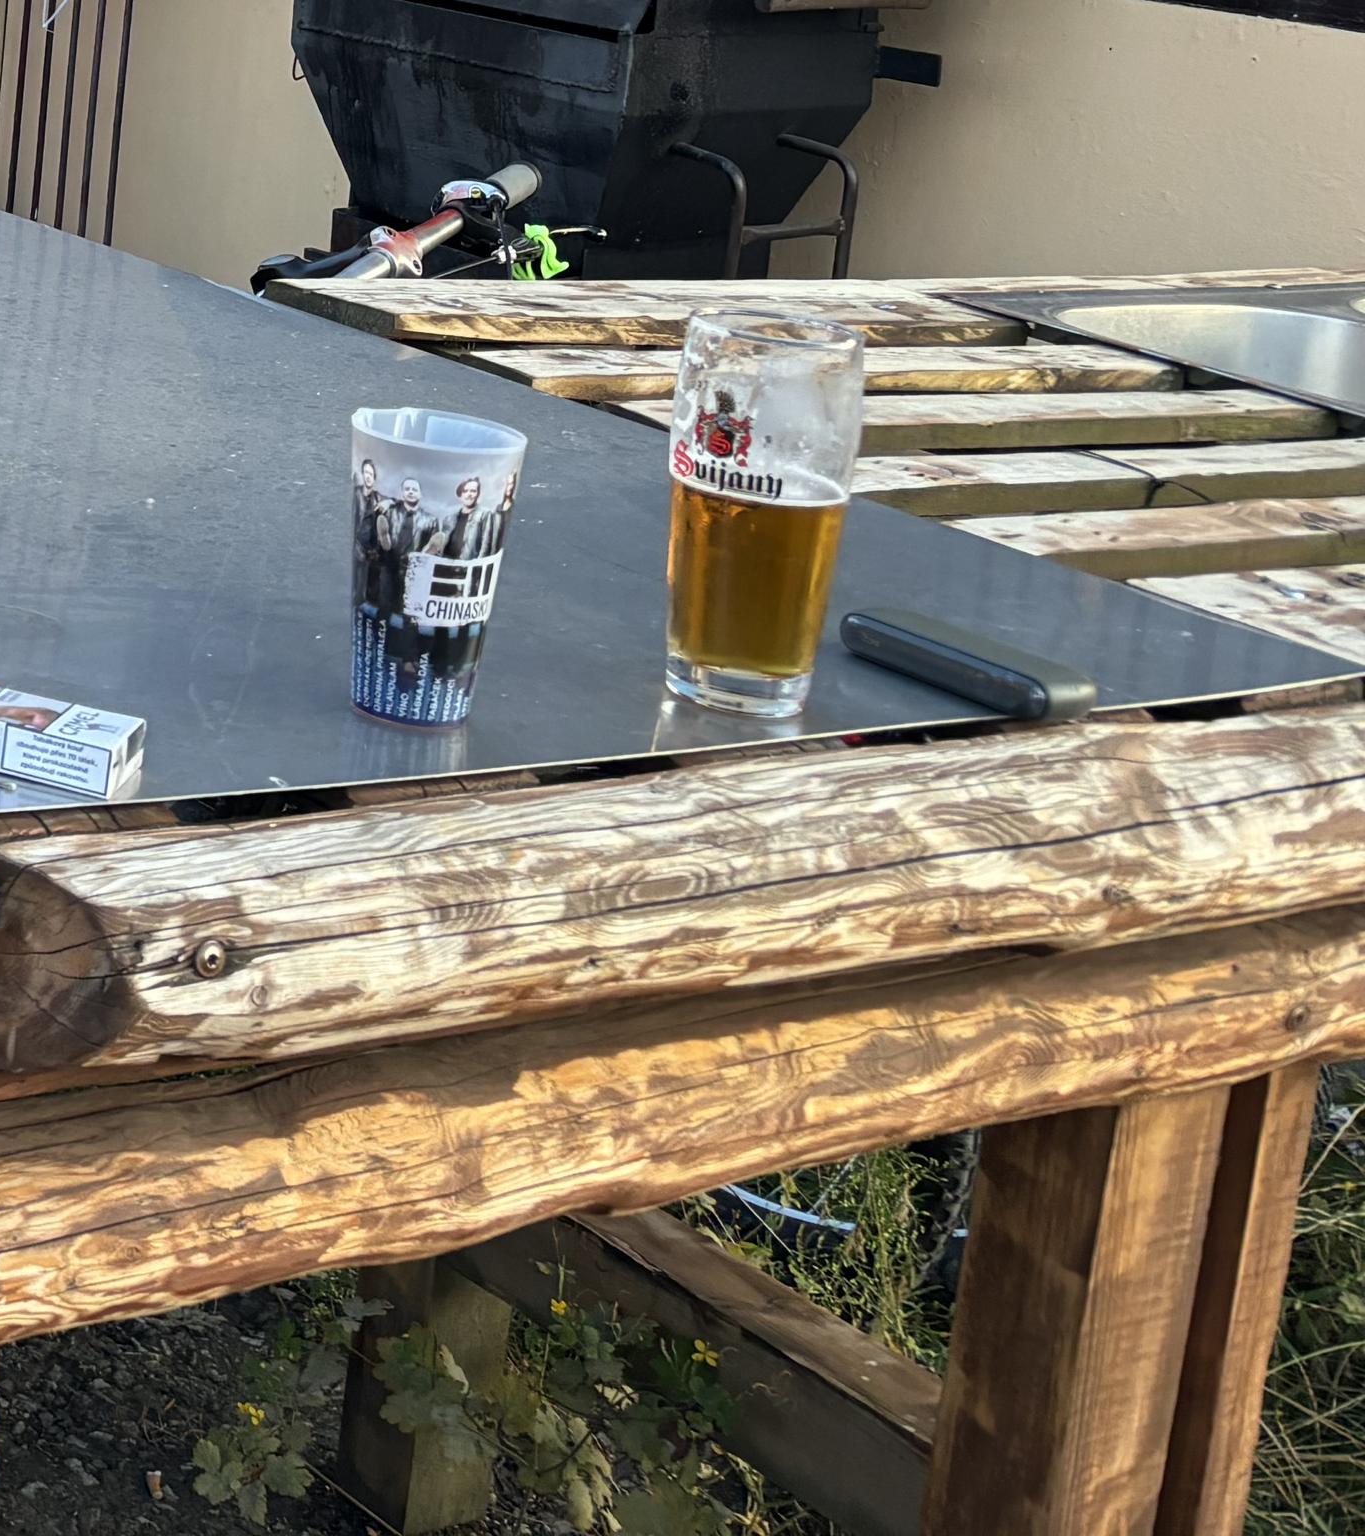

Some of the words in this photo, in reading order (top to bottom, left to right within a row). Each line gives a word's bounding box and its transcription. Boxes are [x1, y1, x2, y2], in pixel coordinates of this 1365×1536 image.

[674, 440, 783, 500] Svijany
[418, 652, 430, 677] DATA
[385, 661, 397, 714] HLAVOLAM
[399, 692, 409, 718] VÍNO
[427, 676, 442, 722] TABÁČEK
[57, 709, 100, 737] CAMEL
